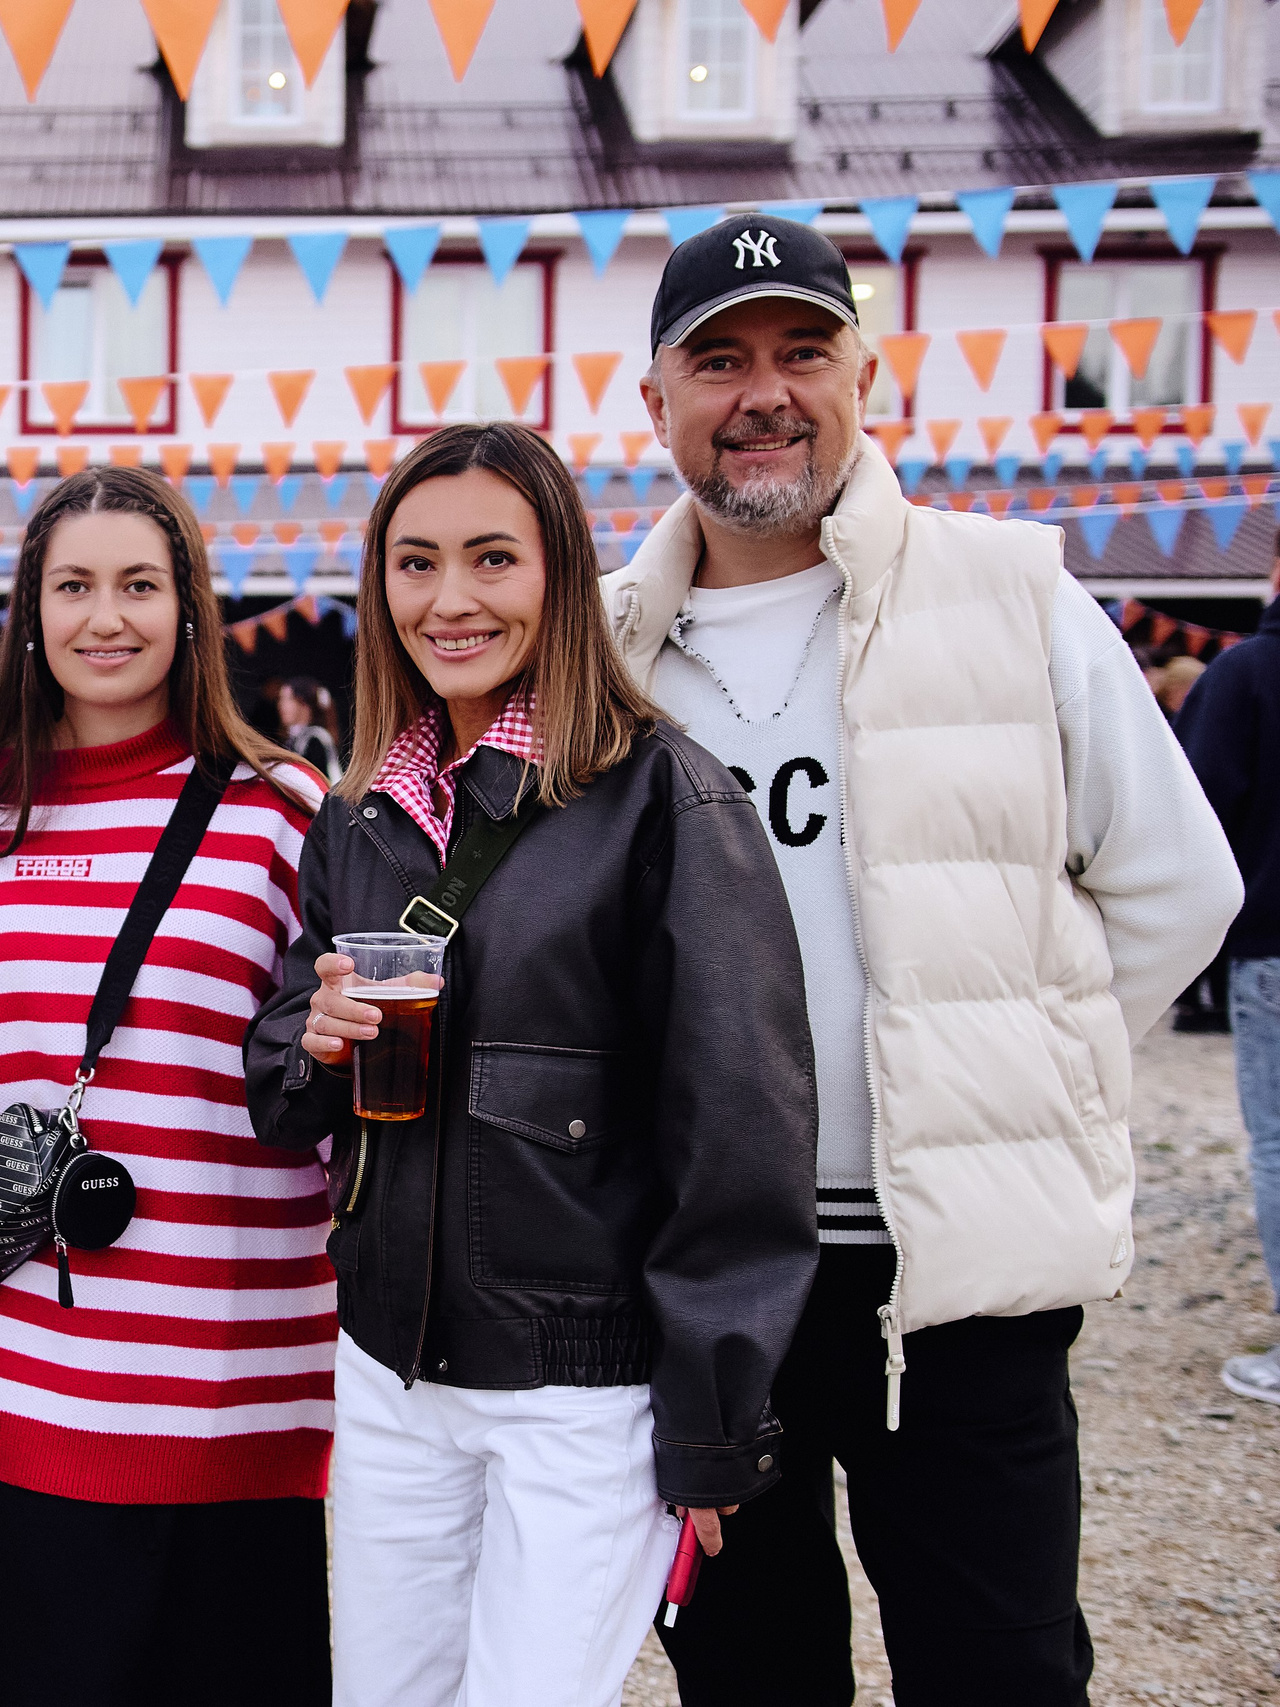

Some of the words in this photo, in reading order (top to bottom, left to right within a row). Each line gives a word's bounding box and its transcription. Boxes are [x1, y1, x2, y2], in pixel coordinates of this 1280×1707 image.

[732, 229, 782, 270] NY
[0, 1135, 24, 1148] GUESS
[4, 1160, 30, 1172] GUESS
[12, 1184, 36, 1196] GUESS
[81, 1177, 119, 1190] GUESS
